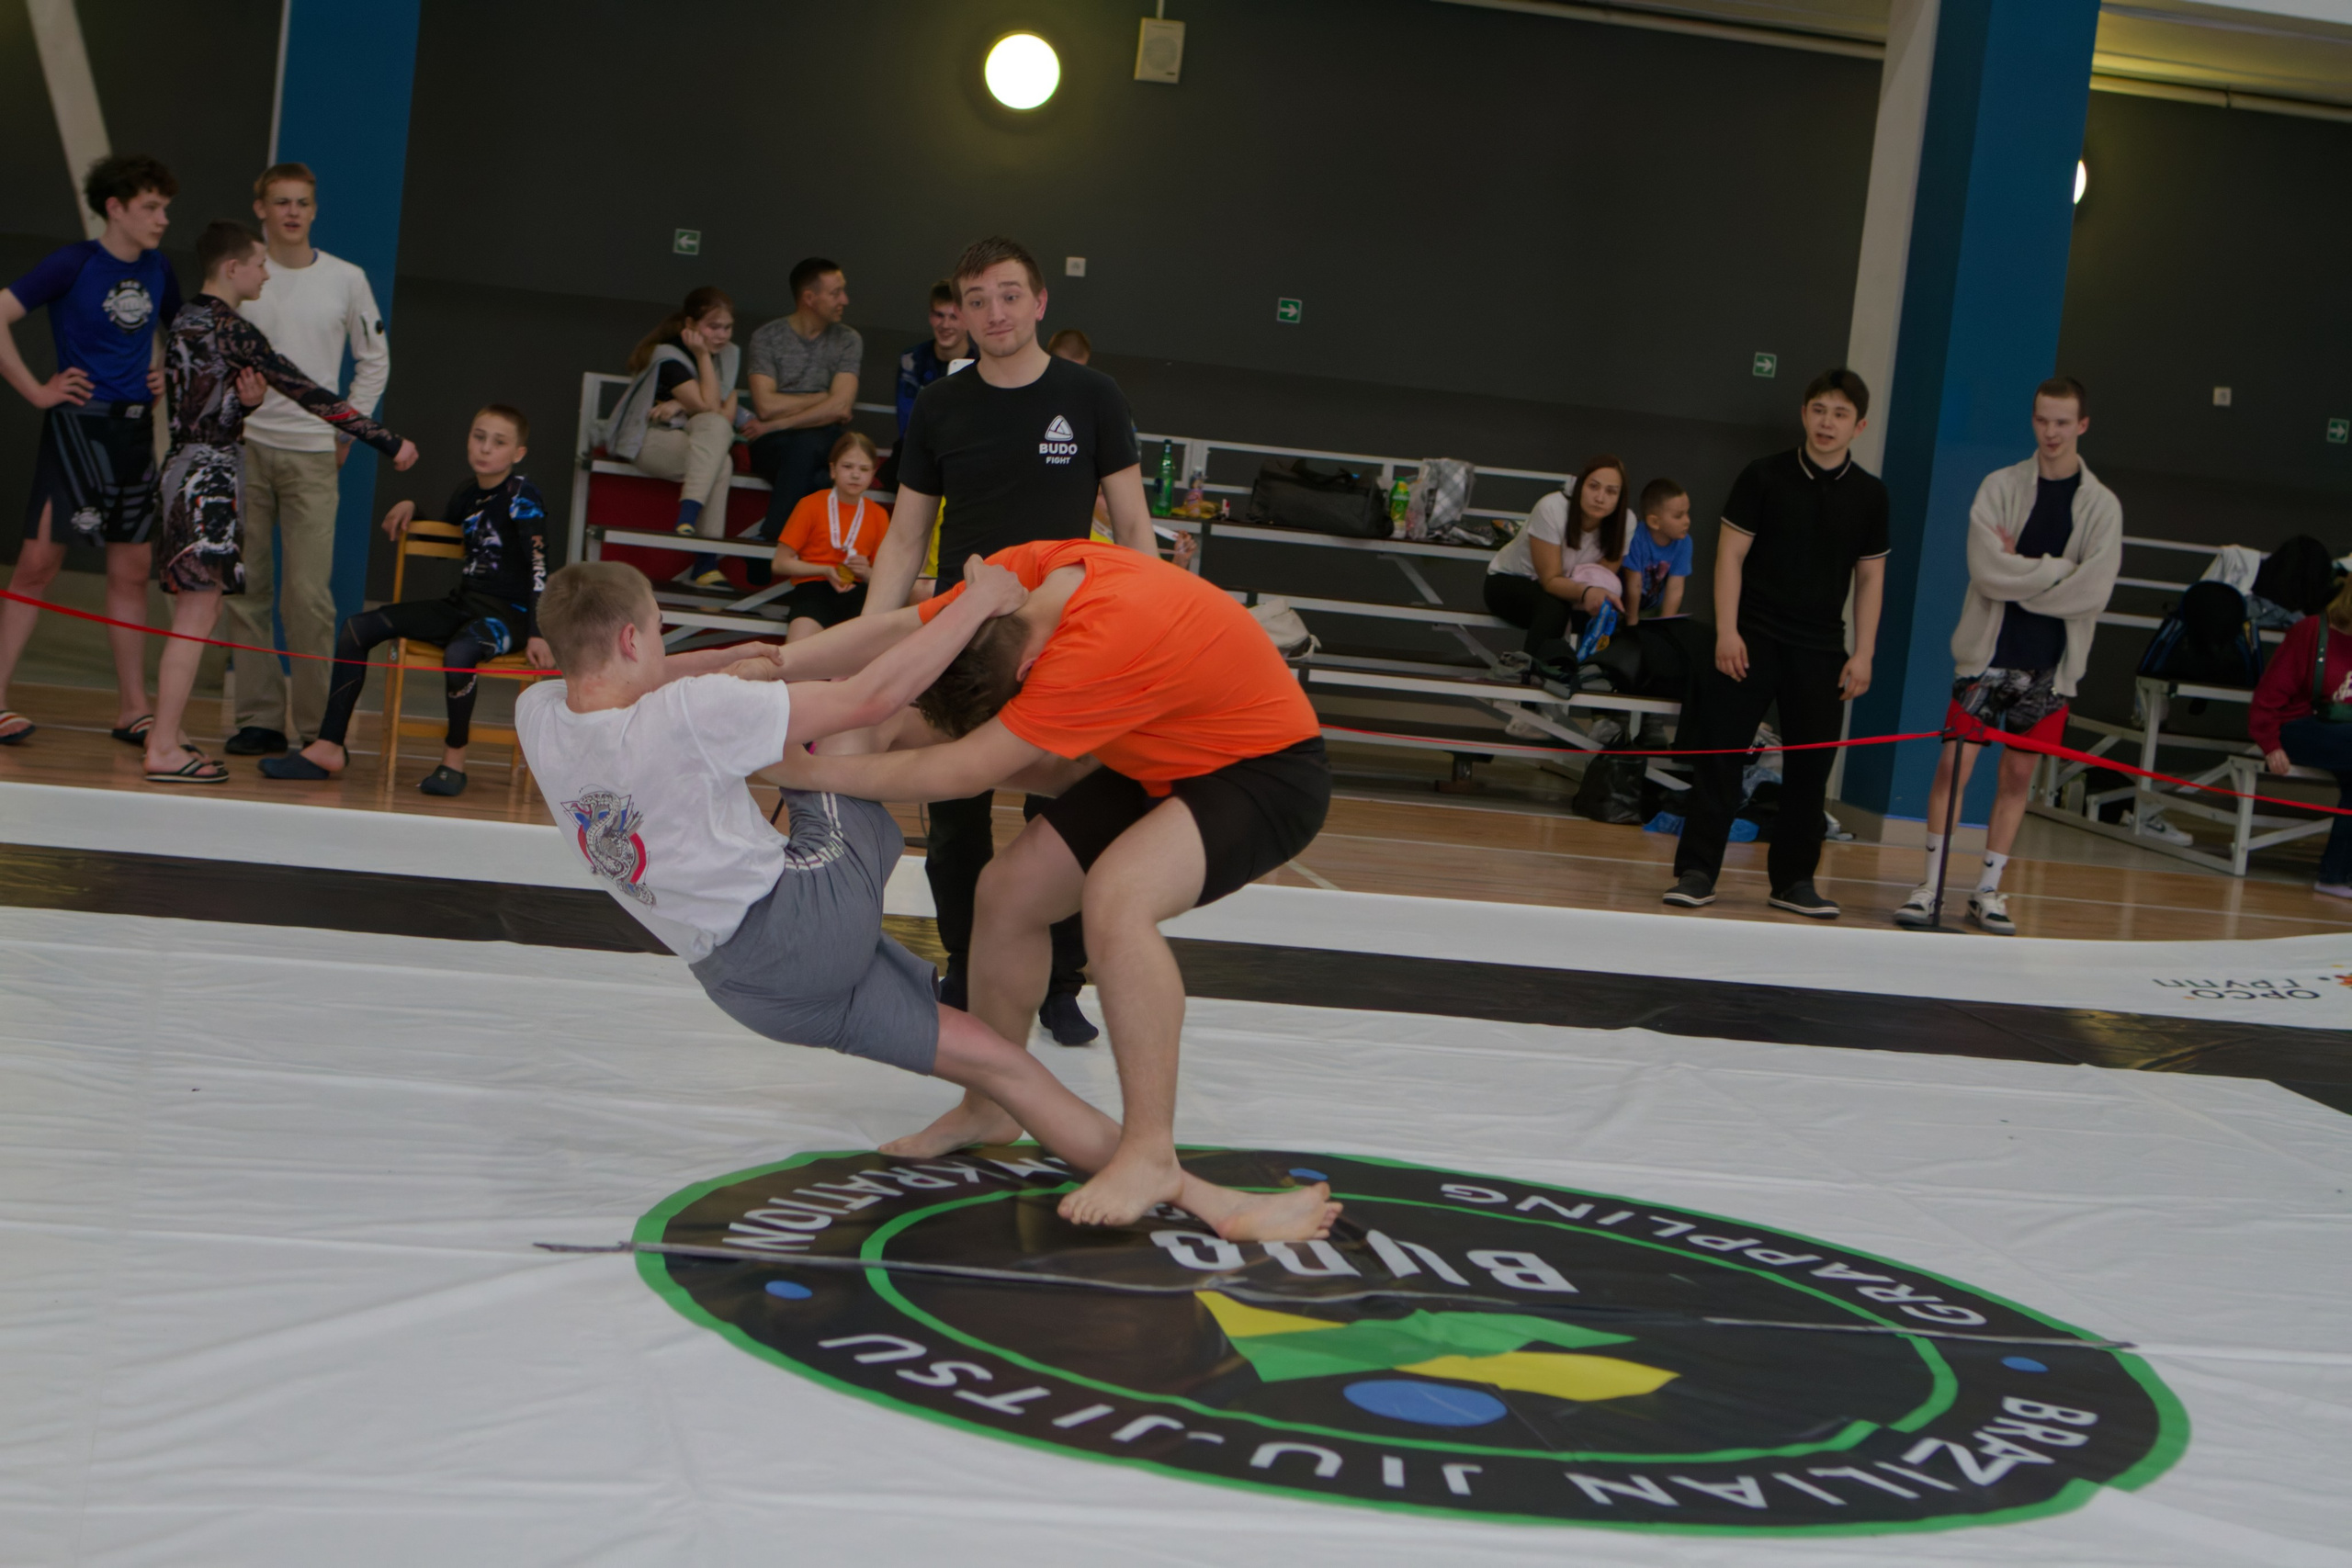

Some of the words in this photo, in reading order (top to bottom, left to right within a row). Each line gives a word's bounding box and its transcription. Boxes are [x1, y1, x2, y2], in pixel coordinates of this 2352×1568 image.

[1038, 443, 1078, 455] BUDO
[1046, 457, 1071, 465] FIGHT
[2191, 988, 2321, 999] ОРСО
[722, 1157, 1072, 1251] NKRATION
[1440, 1183, 1986, 1327] GRAPPLING
[819, 1334, 1484, 1496] JIU-JITSU
[1564, 1396, 2098, 1509] BRAZILIAN
